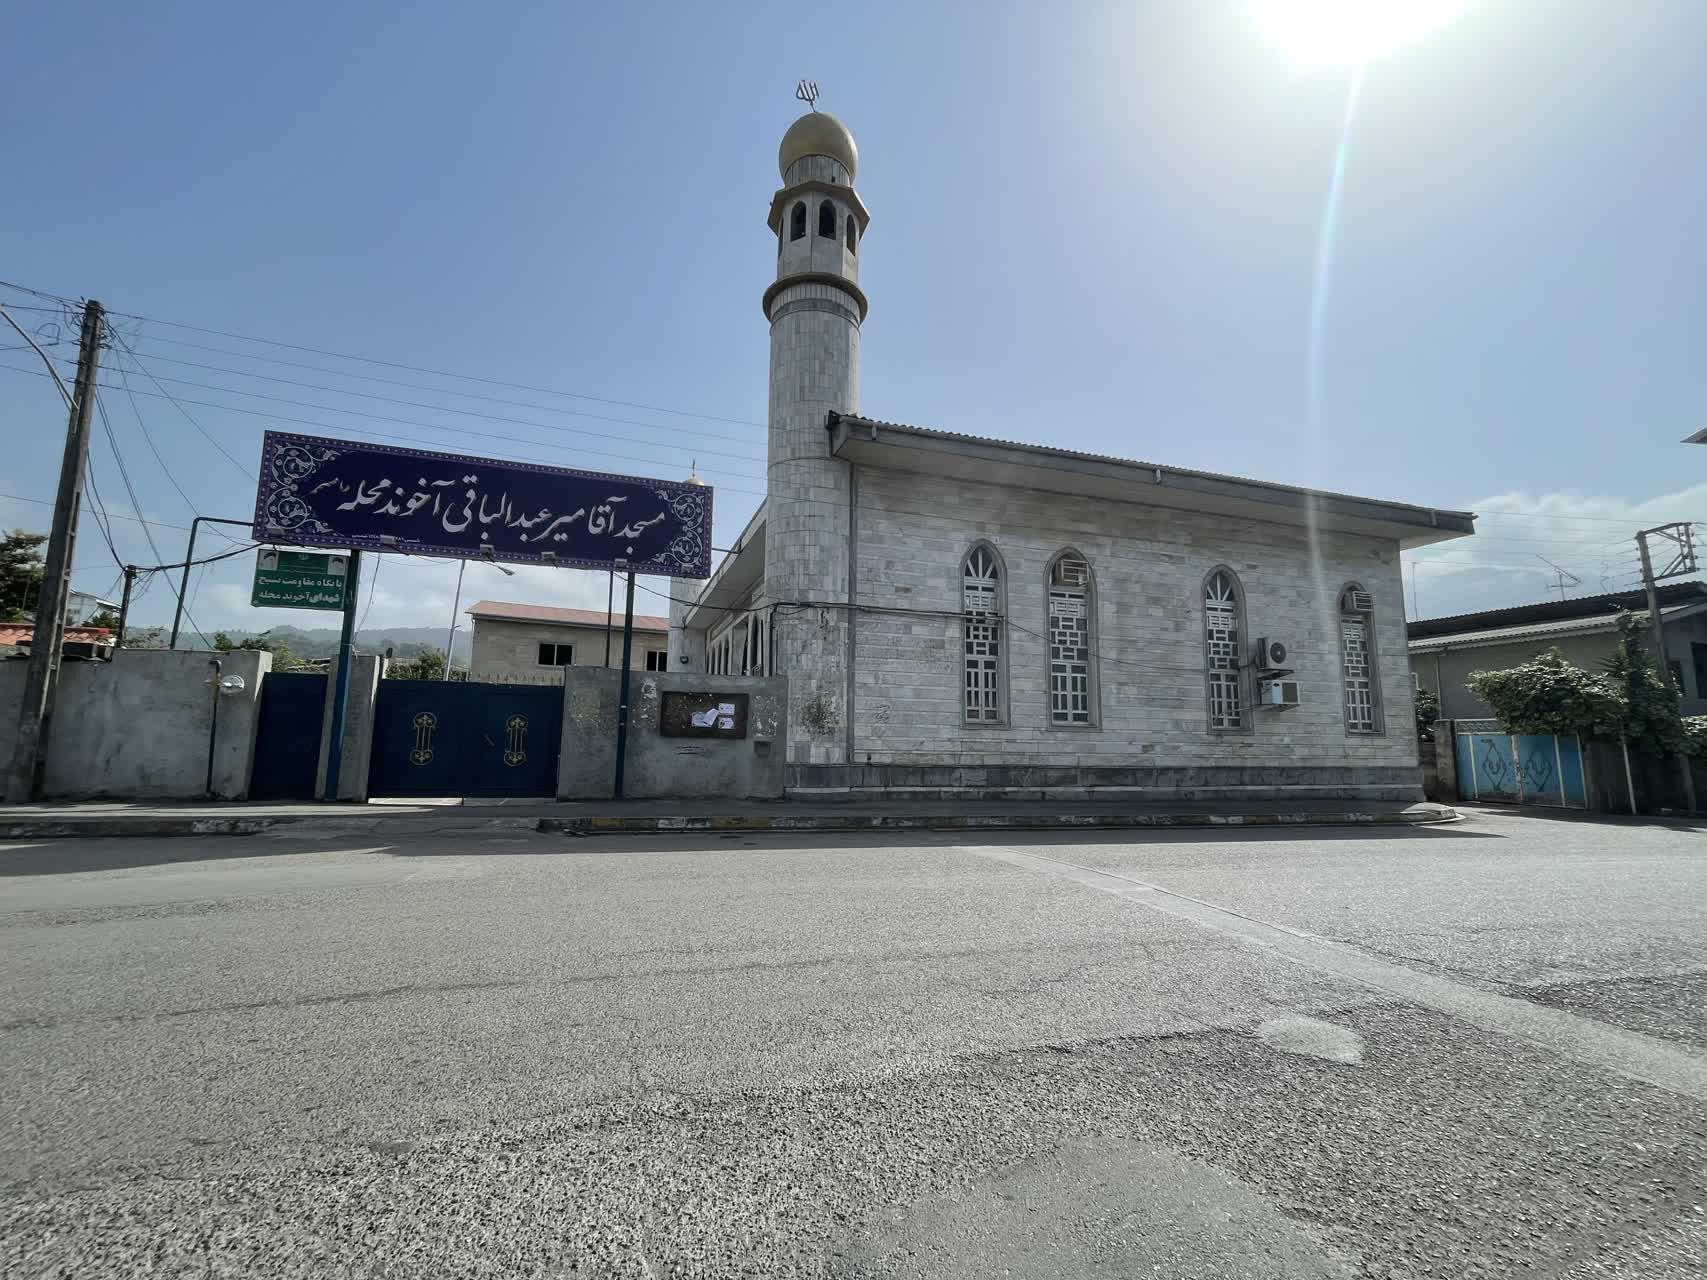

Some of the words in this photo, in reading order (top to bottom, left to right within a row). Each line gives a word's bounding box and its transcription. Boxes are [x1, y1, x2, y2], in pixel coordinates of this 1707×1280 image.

[336, 478, 392, 511] محله
[373, 478, 456, 517] آخوند
[529, 508, 585, 542] میر
[588, 496, 627, 534] آقا
[611, 512, 665, 555] مسجد
